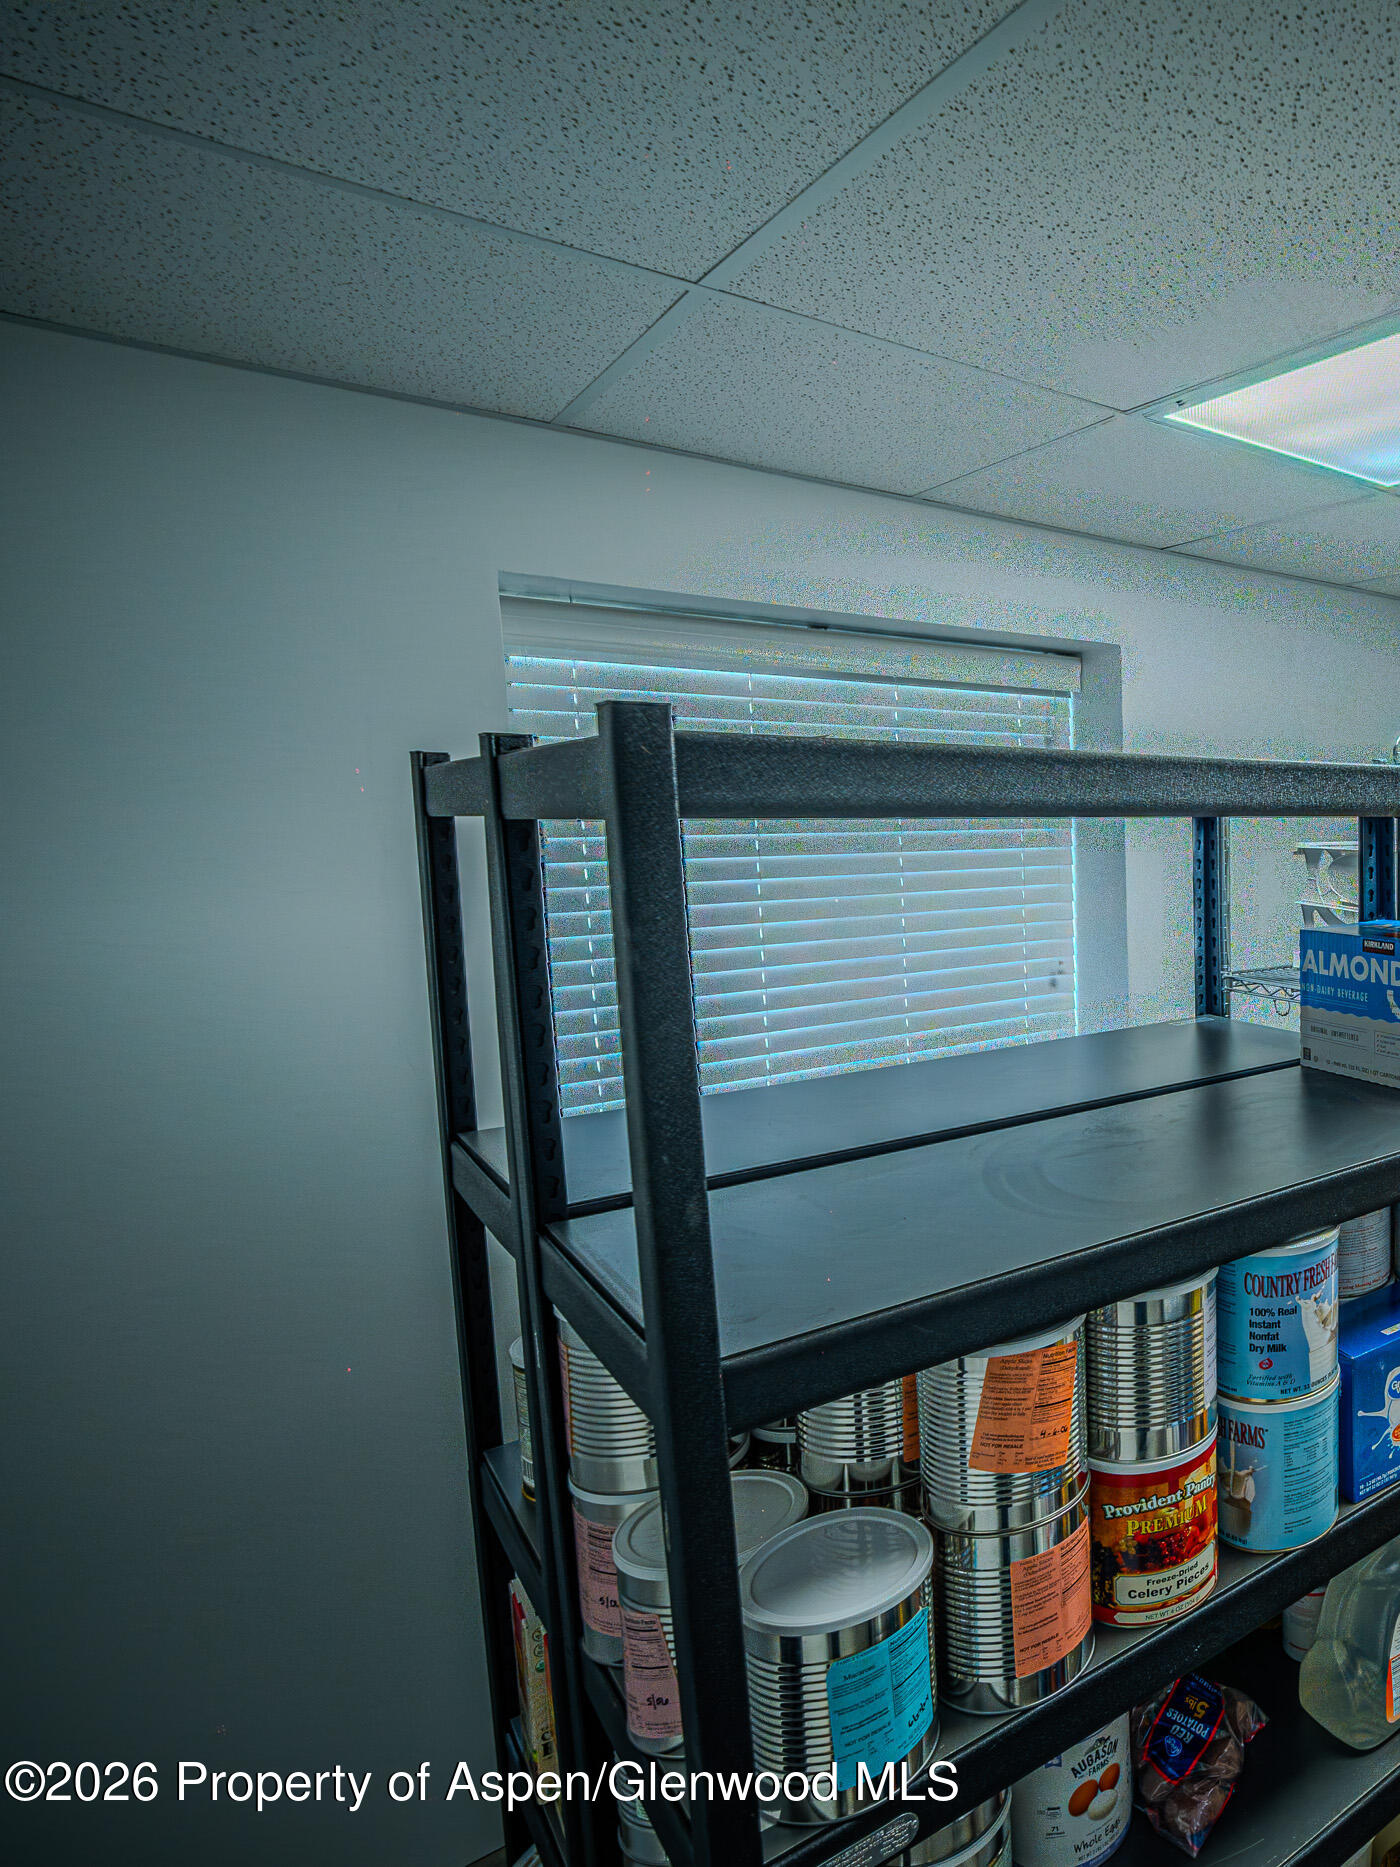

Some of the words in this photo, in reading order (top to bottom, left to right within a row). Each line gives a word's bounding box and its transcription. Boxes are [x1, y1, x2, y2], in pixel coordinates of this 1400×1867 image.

[1364, 940, 1394, 951] KIRKLAND
[1337, 987, 1368, 1003] BEVERAGE
[1244, 1272, 1302, 1299] COUNTRY
[1303, 1260, 1331, 1291] FRESH
[1249, 1308, 1276, 1317] 100%
[1277, 1306, 1298, 1316] Real
[1249, 1320, 1281, 1329] Instant
[1249, 1332, 1280, 1341] Nonfat
[1043, 1350, 1065, 1359] Nutrition
[1249, 1344, 1265, 1354] Dry
[1267, 1344, 1288, 1353] Milk
[1248, 1374, 1277, 1382] Fortified
[1229, 1421, 1266, 1449] FARMS
[1103, 1488, 1184, 1519] Provident
[1184, 1473, 1216, 1498] Pantry
[1126, 1495, 1208, 1537] PREMIUM
[1128, 1584, 1173, 1599] Celery
[1176, 1563, 1209, 1590] Pieces
[1146, 1561, 1199, 1587] Freeze-Dried
[1145, 1613, 1158, 1621] NET
[1175, 1604, 1184, 1613] OZ
[1184, 1696, 1197, 1710] lbs
[1194, 1701, 1209, 1719] 5
[1166, 1707, 1210, 1738] POTATOES
[845, 1740, 857, 1748] NOT
[858, 1733, 870, 1742] FOR
[871, 1722, 892, 1734] RESALE
[1170, 1724, 1194, 1744] RED
[1071, 1739, 1119, 1779] AUGASON
[1088, 1757, 1110, 1777] FARMS
[1074, 1833, 1103, 1854] Whole
[1104, 1818, 1121, 1837] Eggs
